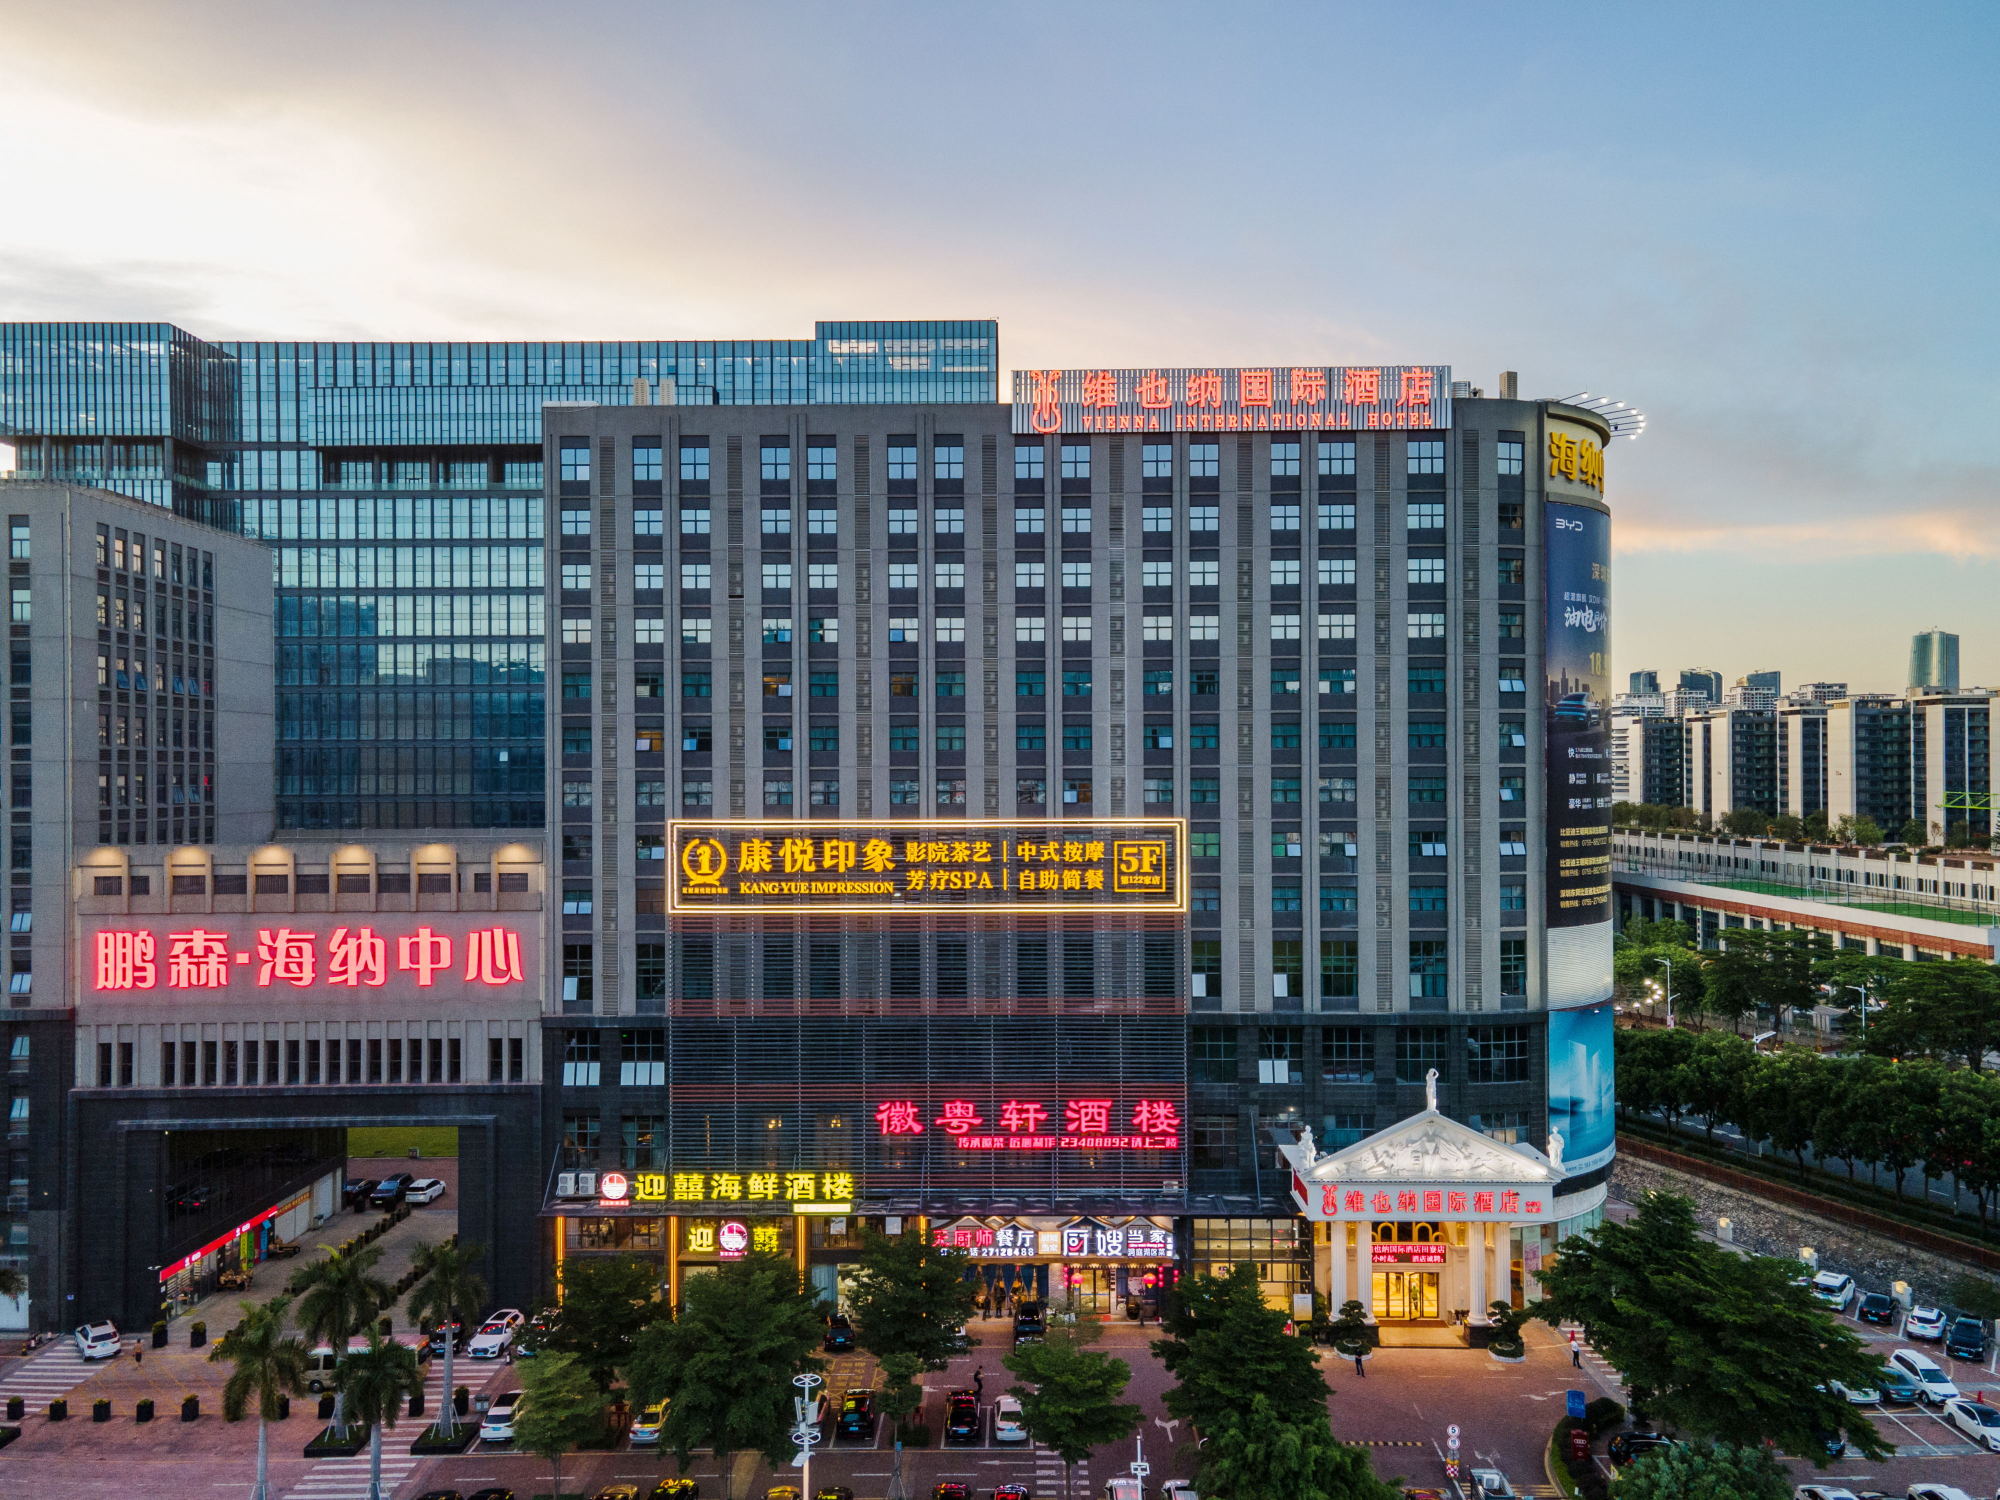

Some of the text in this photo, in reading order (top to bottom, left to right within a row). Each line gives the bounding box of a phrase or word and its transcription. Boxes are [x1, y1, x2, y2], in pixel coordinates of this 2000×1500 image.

[1082, 368, 1433, 408] 维也纳国际酒店
[1083, 412, 1432, 429] VIENNA INTERNATIONAL HOTEL
[1549, 431, 1604, 493] 海纳
[1555, 518, 1583, 532] BYD
[738, 838, 896, 873] 康悦印象
[905, 841, 992, 863] 影院茶艺
[1017, 841, 1105, 863] 中式按摩
[1120, 846, 1161, 873] 5F
[740, 882, 779, 894] KANG
[780, 882, 809, 894] YUE
[811, 881, 894, 894] IMPRESSION
[906, 869, 993, 891] 芳疗SPA
[1018, 869, 1104, 891] 自助简餐
[97, 927, 524, 989] 鹏森·海纳中心
[875, 1099, 1181, 1135] 徽粤轩酒楼
[1060, 1136, 1129, 1148] 23408892
[1344, 1189, 1520, 1214] 维也纳国际酒店
[688, 1227, 714, 1252] 迎
[1370, 1244, 1445, 1254] 也纳国际酒店田寮店
